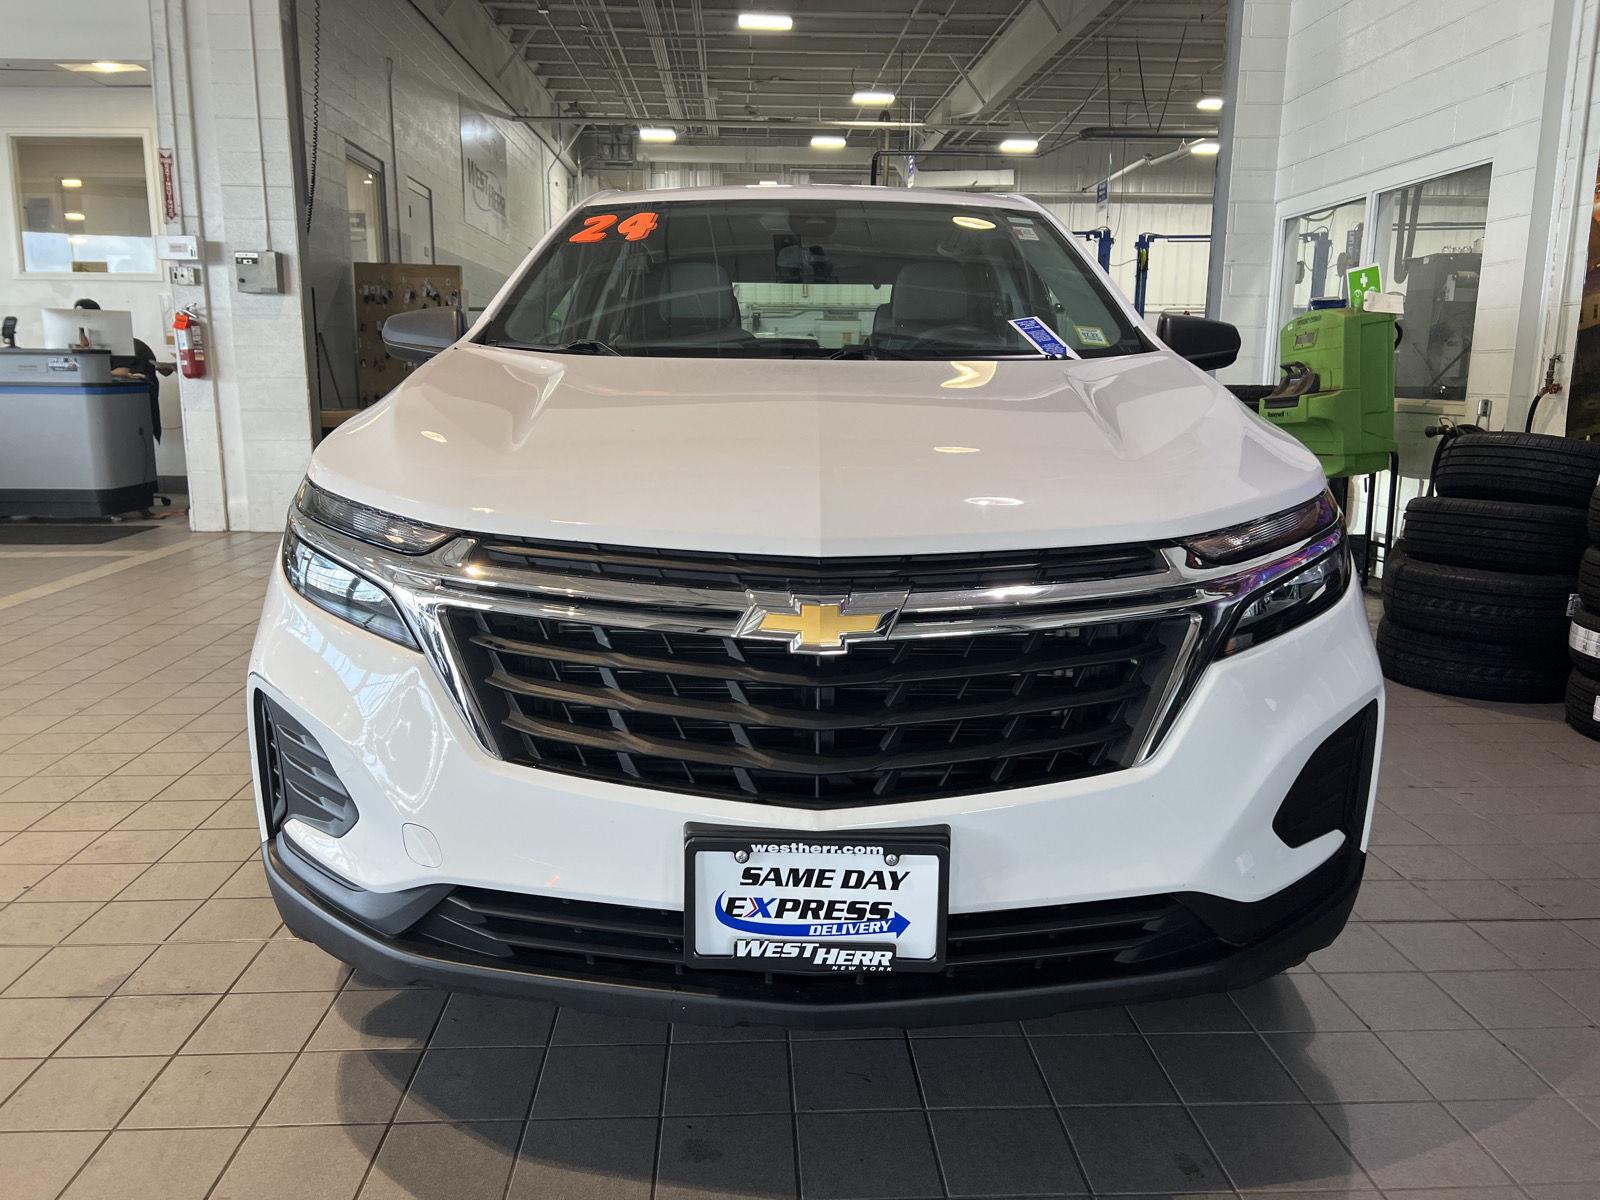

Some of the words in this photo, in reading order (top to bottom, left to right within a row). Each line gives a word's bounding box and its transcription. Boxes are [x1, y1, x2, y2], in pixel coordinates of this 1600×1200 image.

[568, 212, 659, 243] 24
[751, 843, 884, 855] westherr.com
[740, 867, 835, 888] SAME
[841, 870, 910, 891] DAY
[725, 897, 892, 920] EXPRESS
[809, 920, 892, 936] DELIVERY
